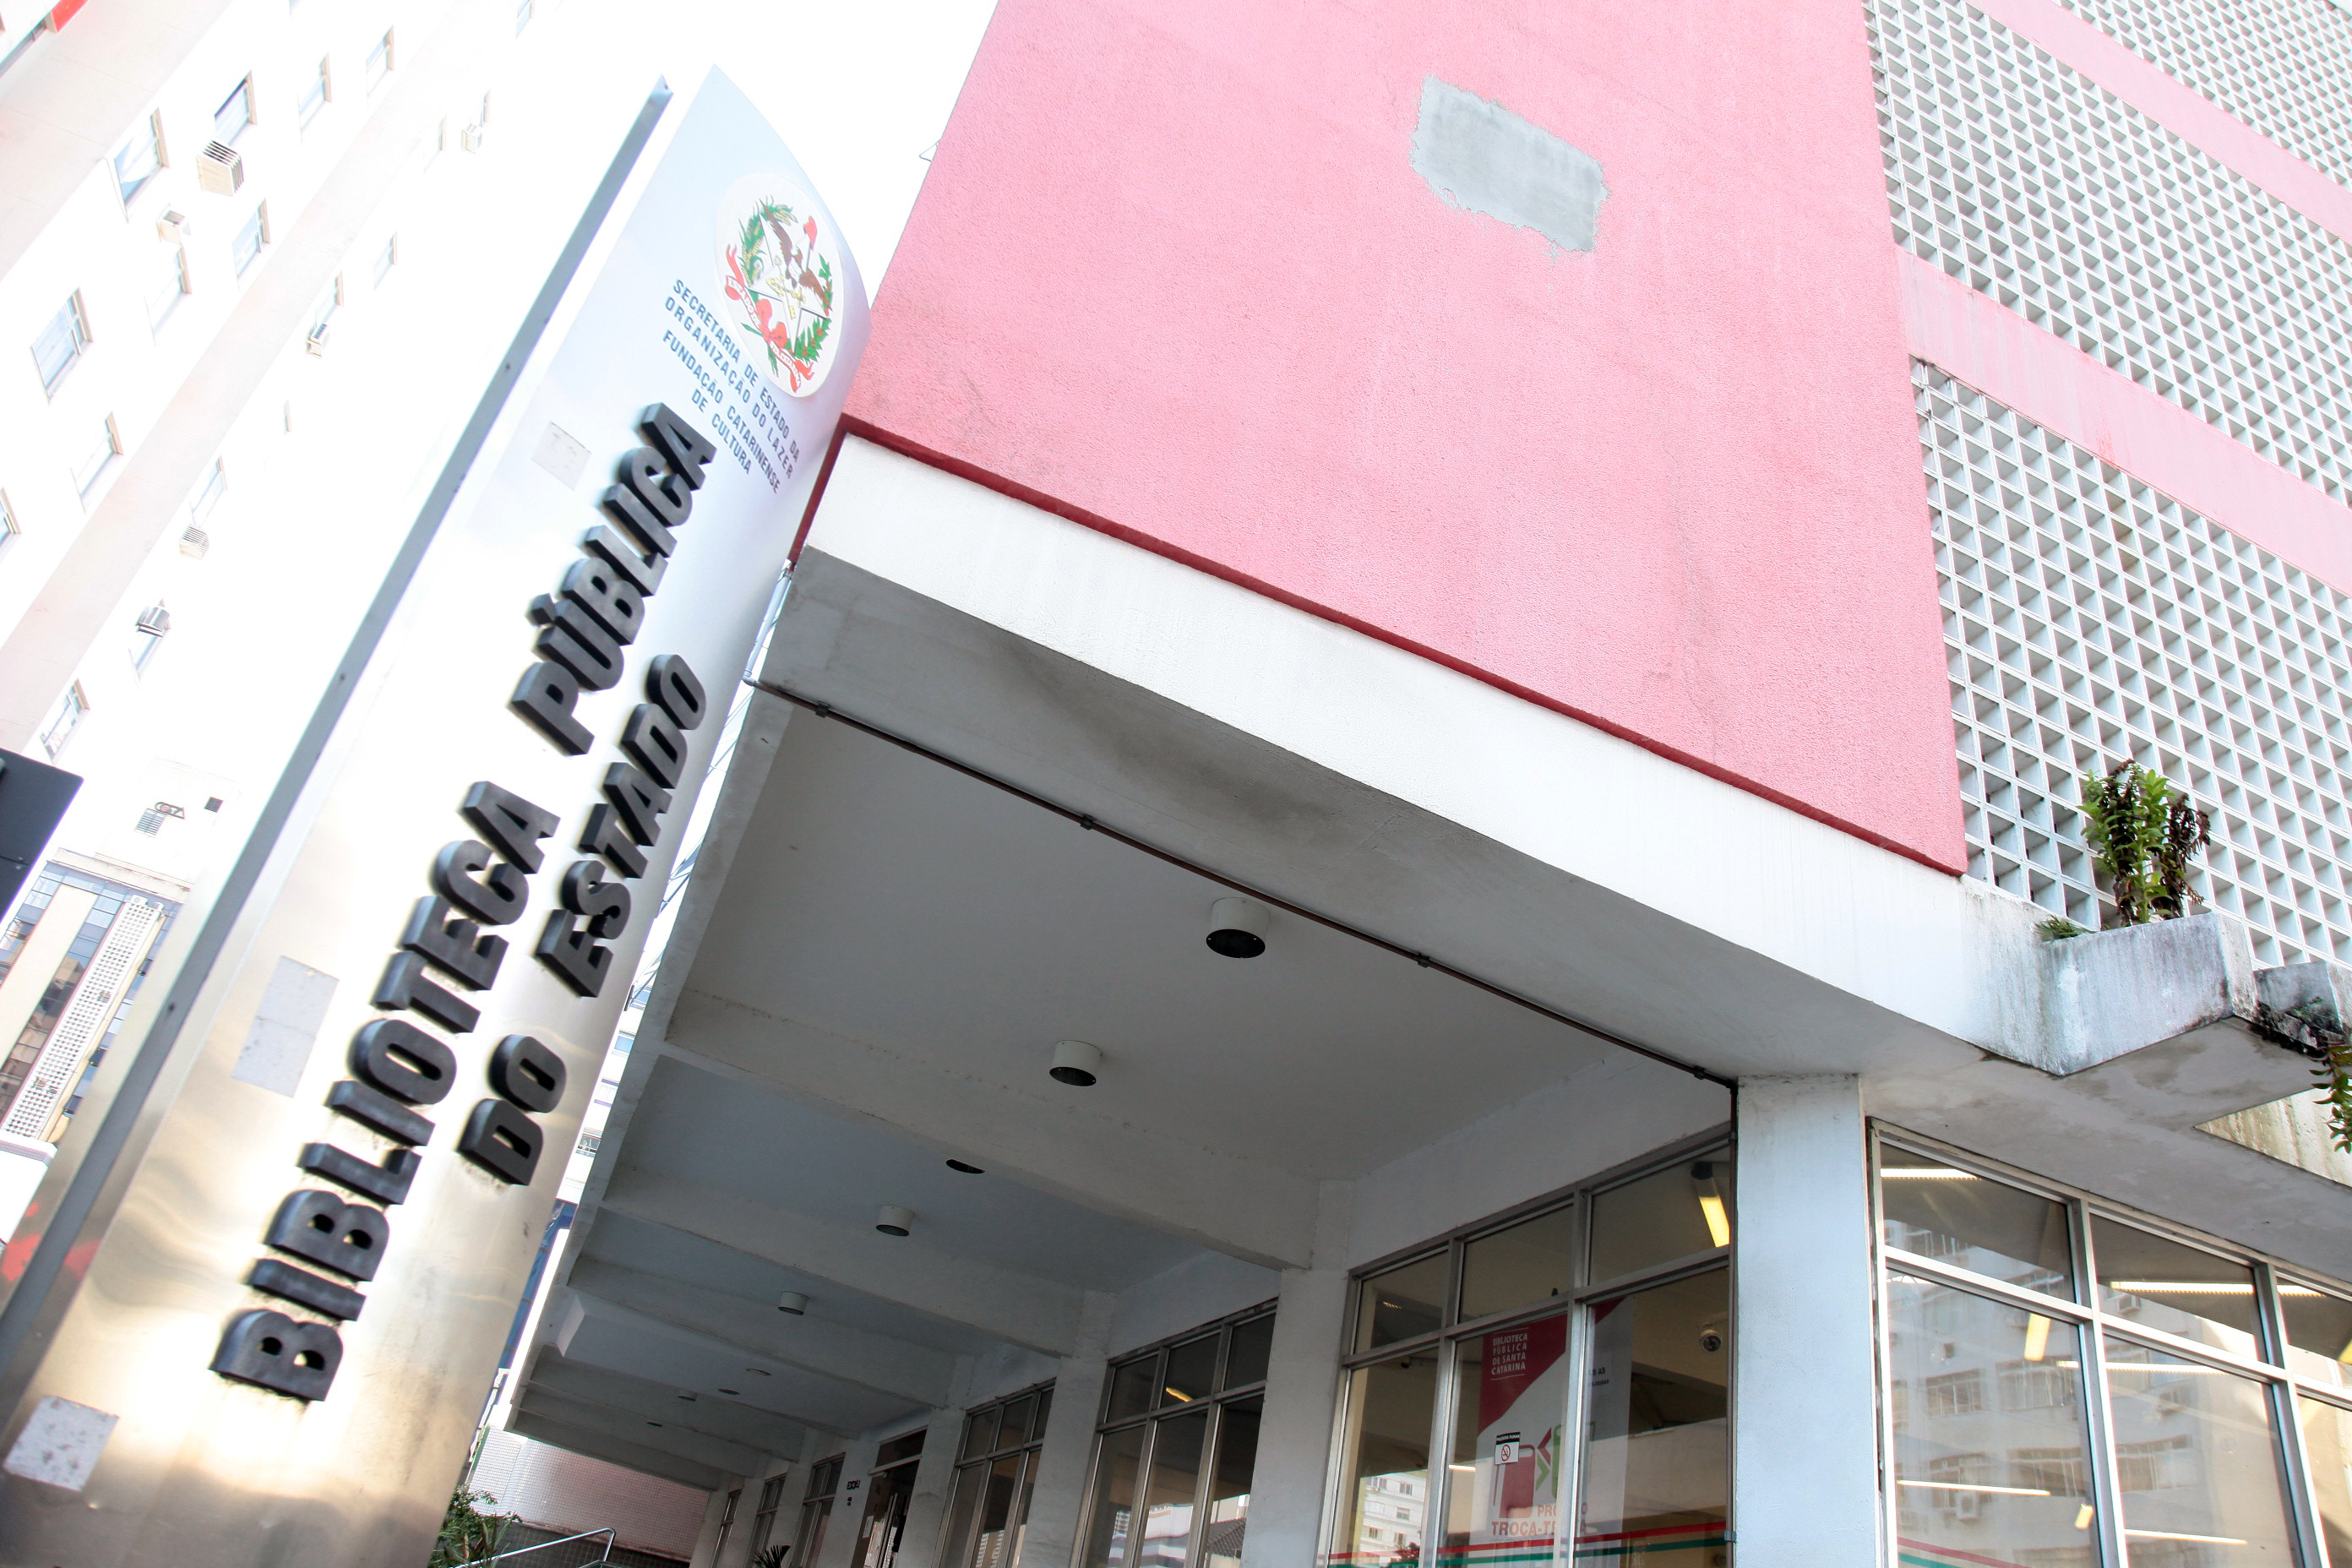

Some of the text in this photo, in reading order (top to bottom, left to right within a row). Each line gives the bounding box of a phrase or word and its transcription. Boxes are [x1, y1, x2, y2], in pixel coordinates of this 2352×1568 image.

[662, 329, 781, 494] FUNDAÇÃO CATARINENSE
[665, 296, 793, 479] ORGANIZAÇÃO DO LAZER
[673, 279, 800, 463] SECRETARIA DE ESTADO DA
[691, 388, 752, 475] DE CULTURA
[208, 401, 717, 1402] BIBLIOTECA PÚBLICA
[455, 653, 708, 1186] DO ESTADO
[1491, 1362, 1526, 1375] CATARINA
[1492, 1353, 1526, 1366] DE SANTA
[1493, 1333, 1527, 1346] BIBLIOTECA
